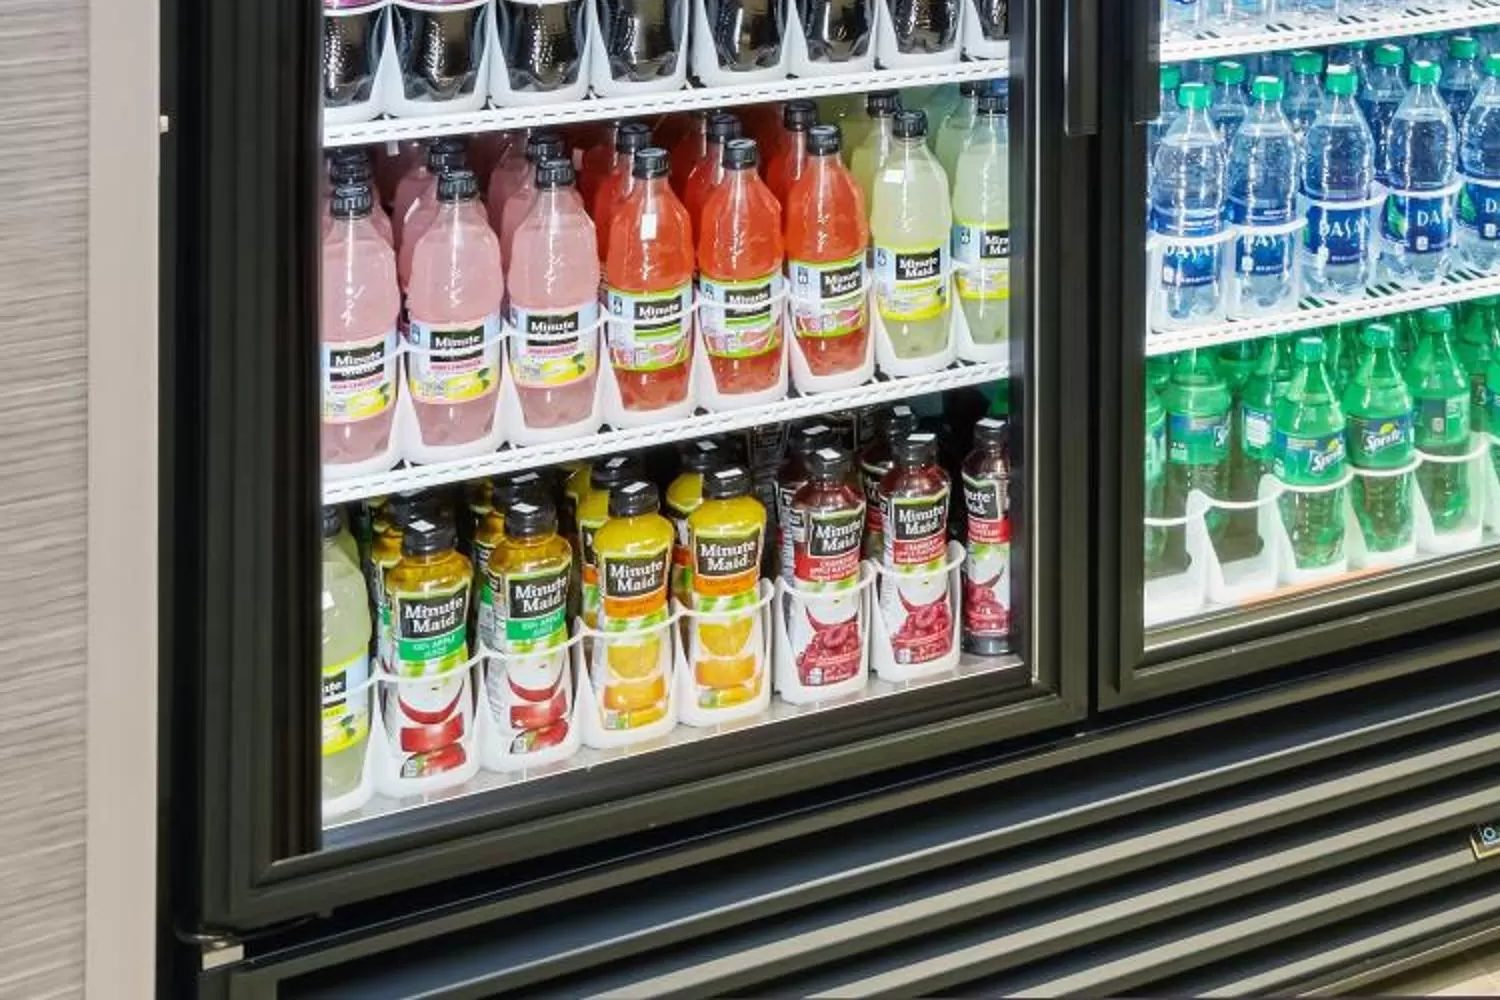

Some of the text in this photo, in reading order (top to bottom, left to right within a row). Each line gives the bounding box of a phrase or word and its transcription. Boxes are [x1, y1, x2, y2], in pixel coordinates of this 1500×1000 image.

[898, 504, 945, 523] Minute
[905, 516, 940, 536] Maid
[700, 540, 756, 558] Minute
[822, 534, 859, 551] Maid
[609, 560, 664, 578] Minute
[707, 553, 749, 571] Maid
[514, 575, 568, 599] Minute
[616, 574, 656, 592] Maid
[404, 597, 463, 620] Minute
[522, 593, 562, 613] Maid
[412, 611, 456, 633] Maid
